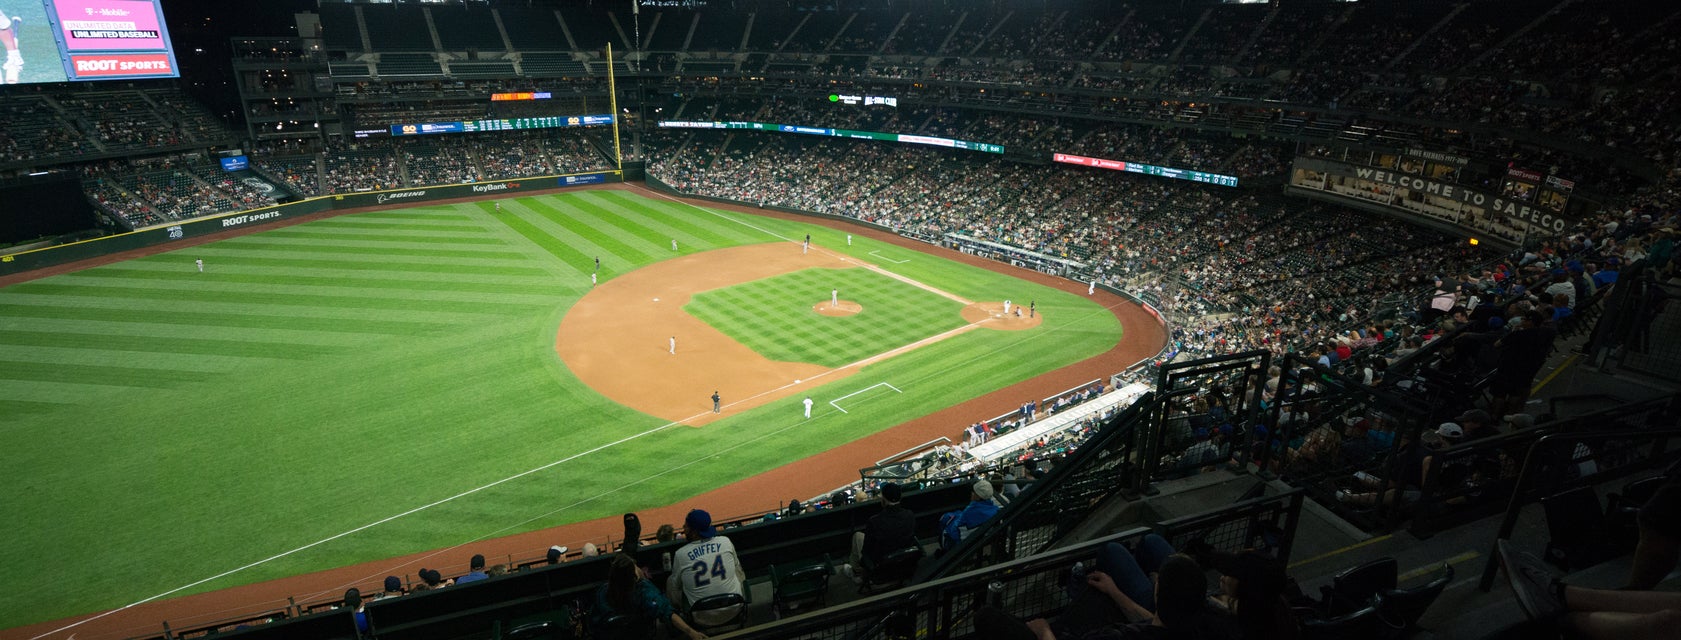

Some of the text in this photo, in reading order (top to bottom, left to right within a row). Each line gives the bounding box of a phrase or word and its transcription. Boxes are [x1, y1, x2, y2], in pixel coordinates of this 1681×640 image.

[66, 22, 133, 30] UNLIMITED DATA
[76, 60, 118, 71] ROOT
[1508, 168, 1523, 177] ROOT
[473, 183, 507, 192] KeyBank
[389, 191, 425, 199] BOEING
[1356, 168, 1566, 232] WELCOME TO SAFECO
[222, 215, 248, 227] ROOT
[687, 543, 721, 560] GRIFFEY
[692, 554, 727, 587] 24
